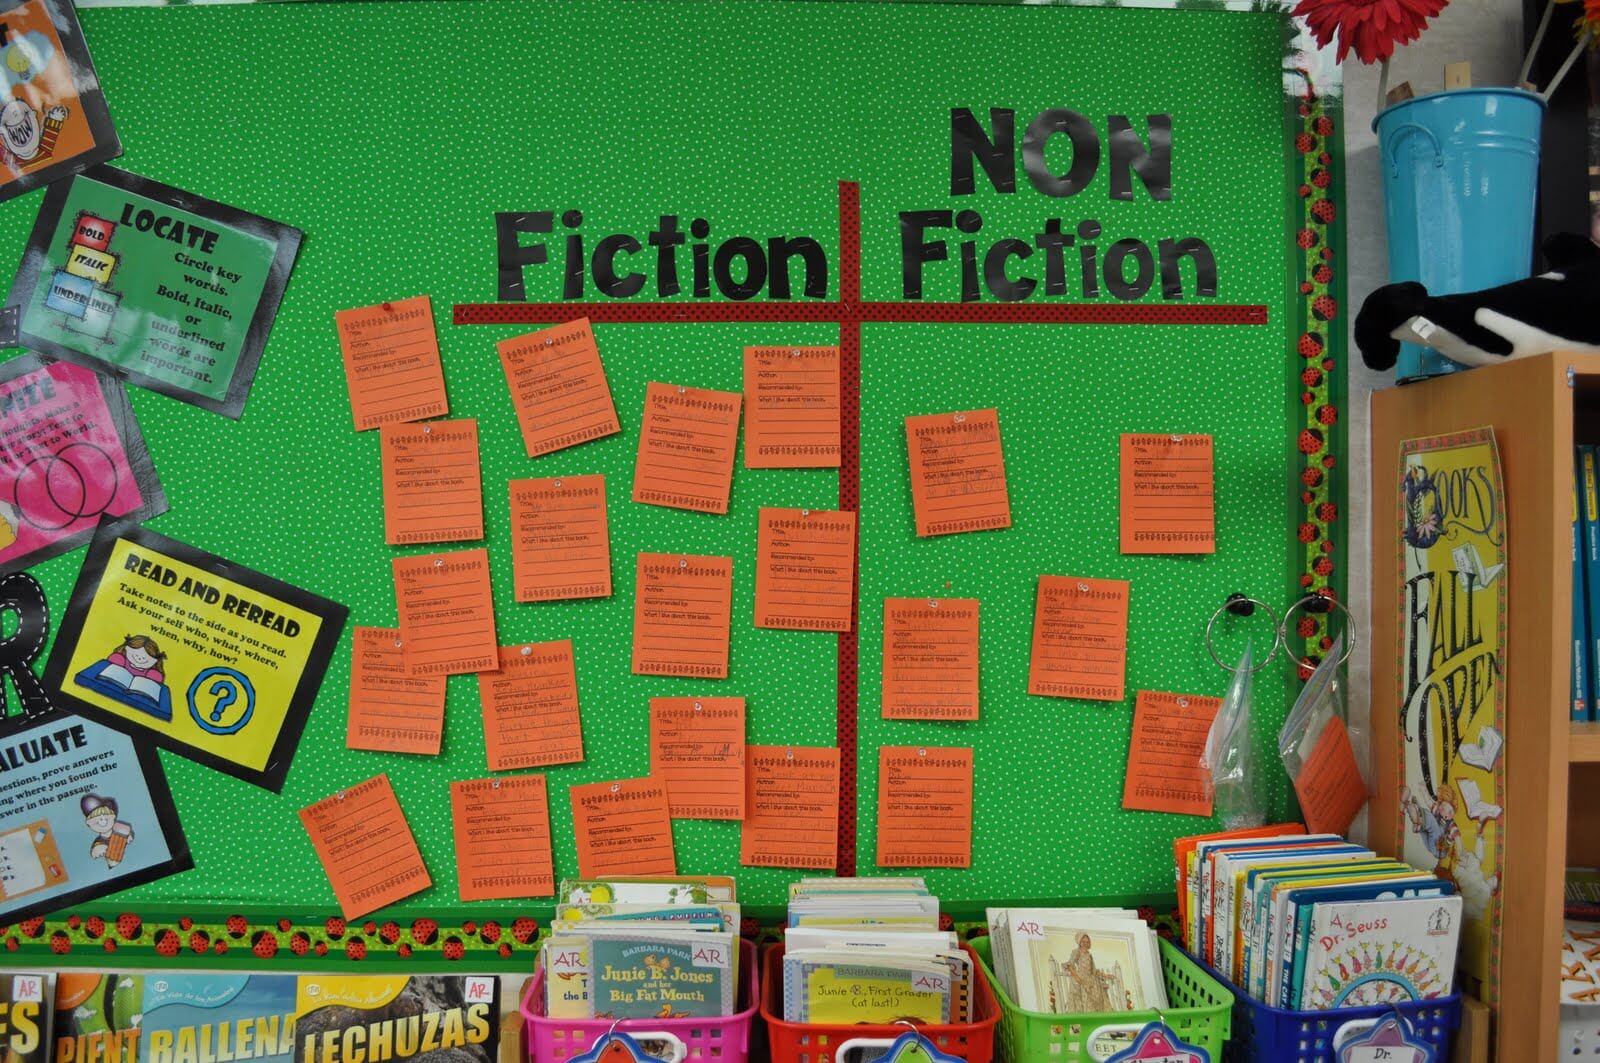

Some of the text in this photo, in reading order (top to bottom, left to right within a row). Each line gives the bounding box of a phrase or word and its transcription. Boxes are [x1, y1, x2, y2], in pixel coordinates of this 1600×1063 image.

[951, 107, 1172, 200] NON
[79, 225, 105, 241] BOLD
[119, 203, 220, 254] LOCATE
[74, 254, 109, 271] ITALIC
[174, 252, 243, 284] Circle key
[495, 210, 828, 300] Fiction
[899, 209, 1218, 302] Fiction
[183, 273, 228, 296] words.
[53, 285, 115, 313] UNDERLINED
[156, 285, 232, 320] Bold, Italic,
[185, 313, 202, 326] or
[151, 320, 225, 352] underlined
[140, 350, 213, 384] important.
[150, 339, 216, 367] words are
[1404, 464, 1500, 548] BOOKS
[124, 553, 301, 638] READ AND REREAD
[117, 597, 279, 670] Ask your self who, what, where,
[119, 583, 287, 658] Take notes to the side as you read.
[150, 623, 239, 665] when, why, how?
[1400, 570, 1484, 718] FALL
[1418, 652, 1500, 800] OPEN
[42, 764, 71, 781] prove
[72, 750, 115, 769] answers
[15, 784, 47, 801] where
[48, 779, 68, 793] you
[68, 768, 99, 783] found
[101, 761, 118, 774] the
[26, 799, 38, 811] in
[38, 793, 56, 807] the
[56, 783, 98, 803] passage.
[1017, 921, 1043, 936] AR
[1319, 917, 1388, 951] Dr. Seuss
[1331, 913, 1343, 929] A
[553, 951, 586, 968] AR
[622, 945, 691, 961] BARBARA PARK
[692, 948, 725, 964] AR
[601, 965, 714, 983] Junie B. Jones
[658, 980, 672, 988] her
[837, 967, 912, 980] BARBARA PAR
[914, 976, 948, 991] AR
[19, 979, 38, 998] AR
[469, 982, 489, 999] AR
[609, 989, 705, 1002] Big Fat Mouth
[818, 985, 847, 997] Junie
[869, 985, 892, 997] First
[1373, 1048, 1392, 1060] Dr.
